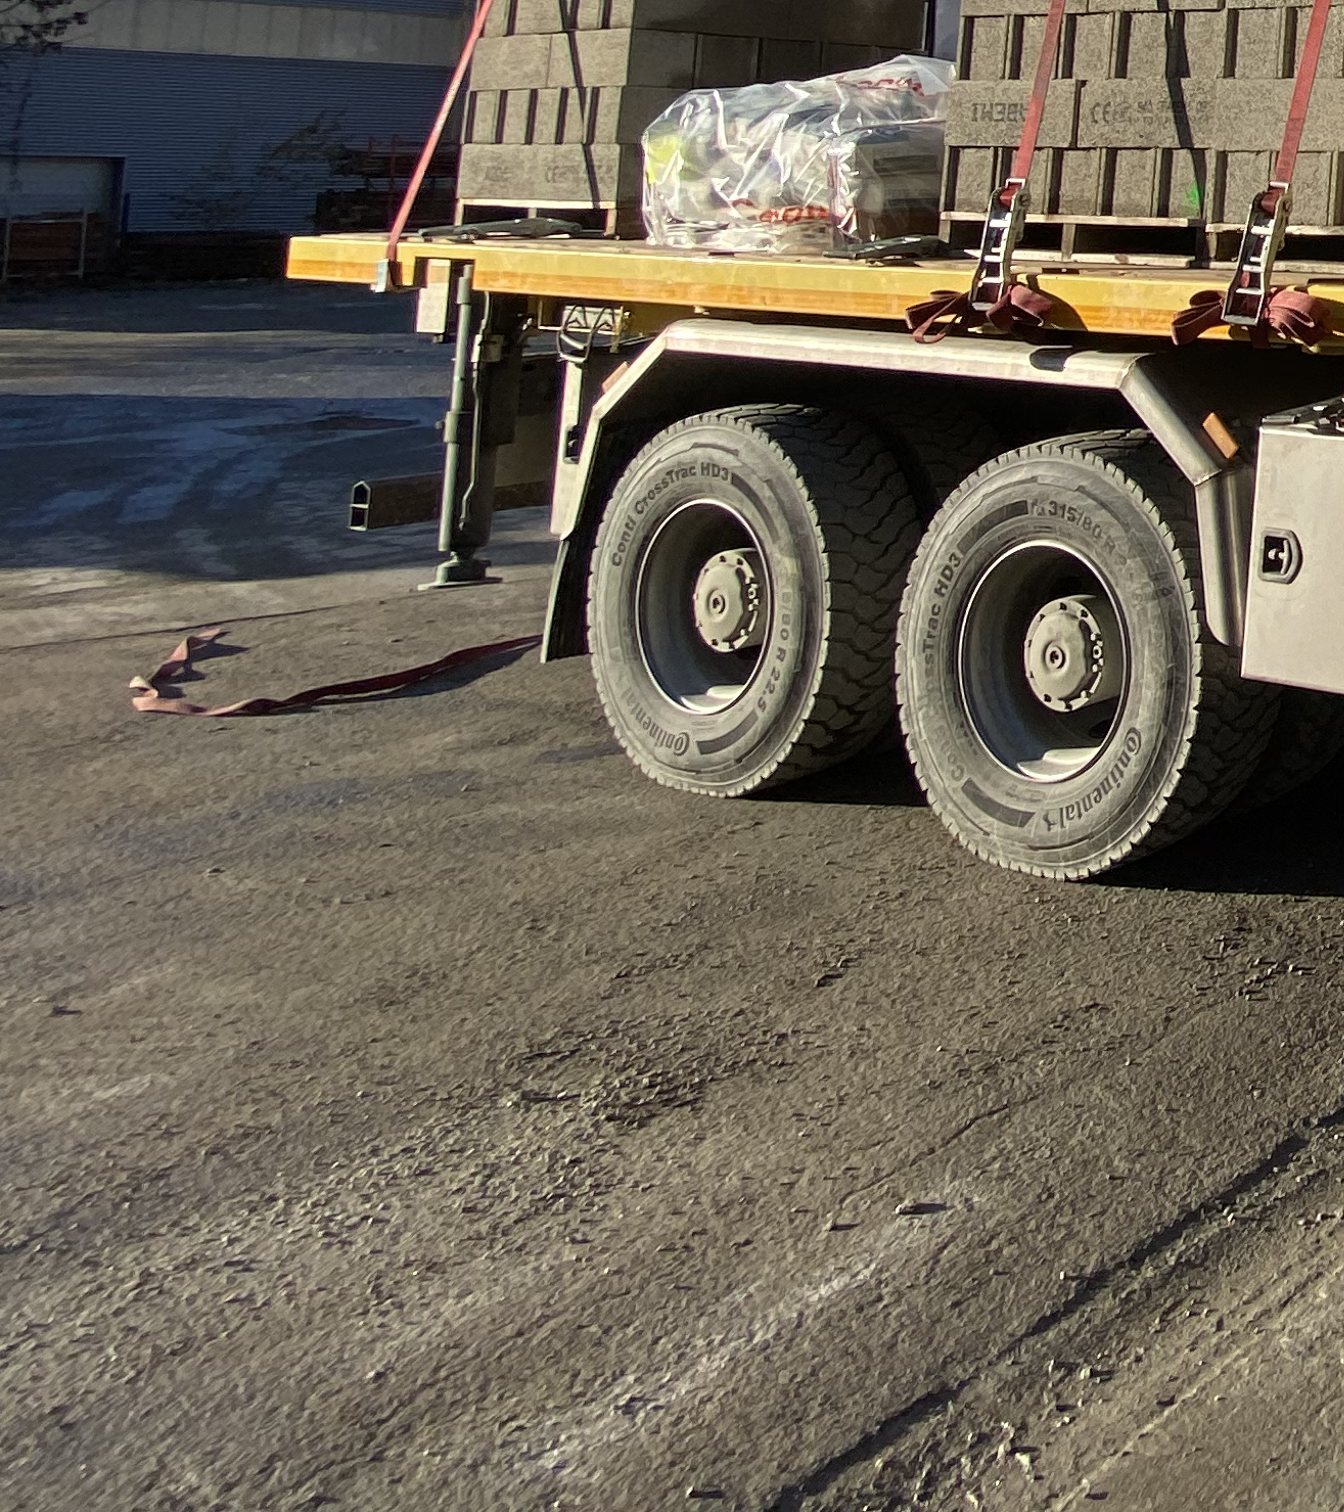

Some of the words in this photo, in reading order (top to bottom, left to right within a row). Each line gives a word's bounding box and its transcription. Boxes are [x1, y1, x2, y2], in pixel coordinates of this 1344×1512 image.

[611, 514, 637, 567] Conti
[634, 465, 697, 515] CrossTrac
[700, 462, 730, 482] HD3
[1048, 500, 1102, 538] 315/80
[934, 551, 961, 598] HD3
[1060, 726, 1142, 829] Continental
